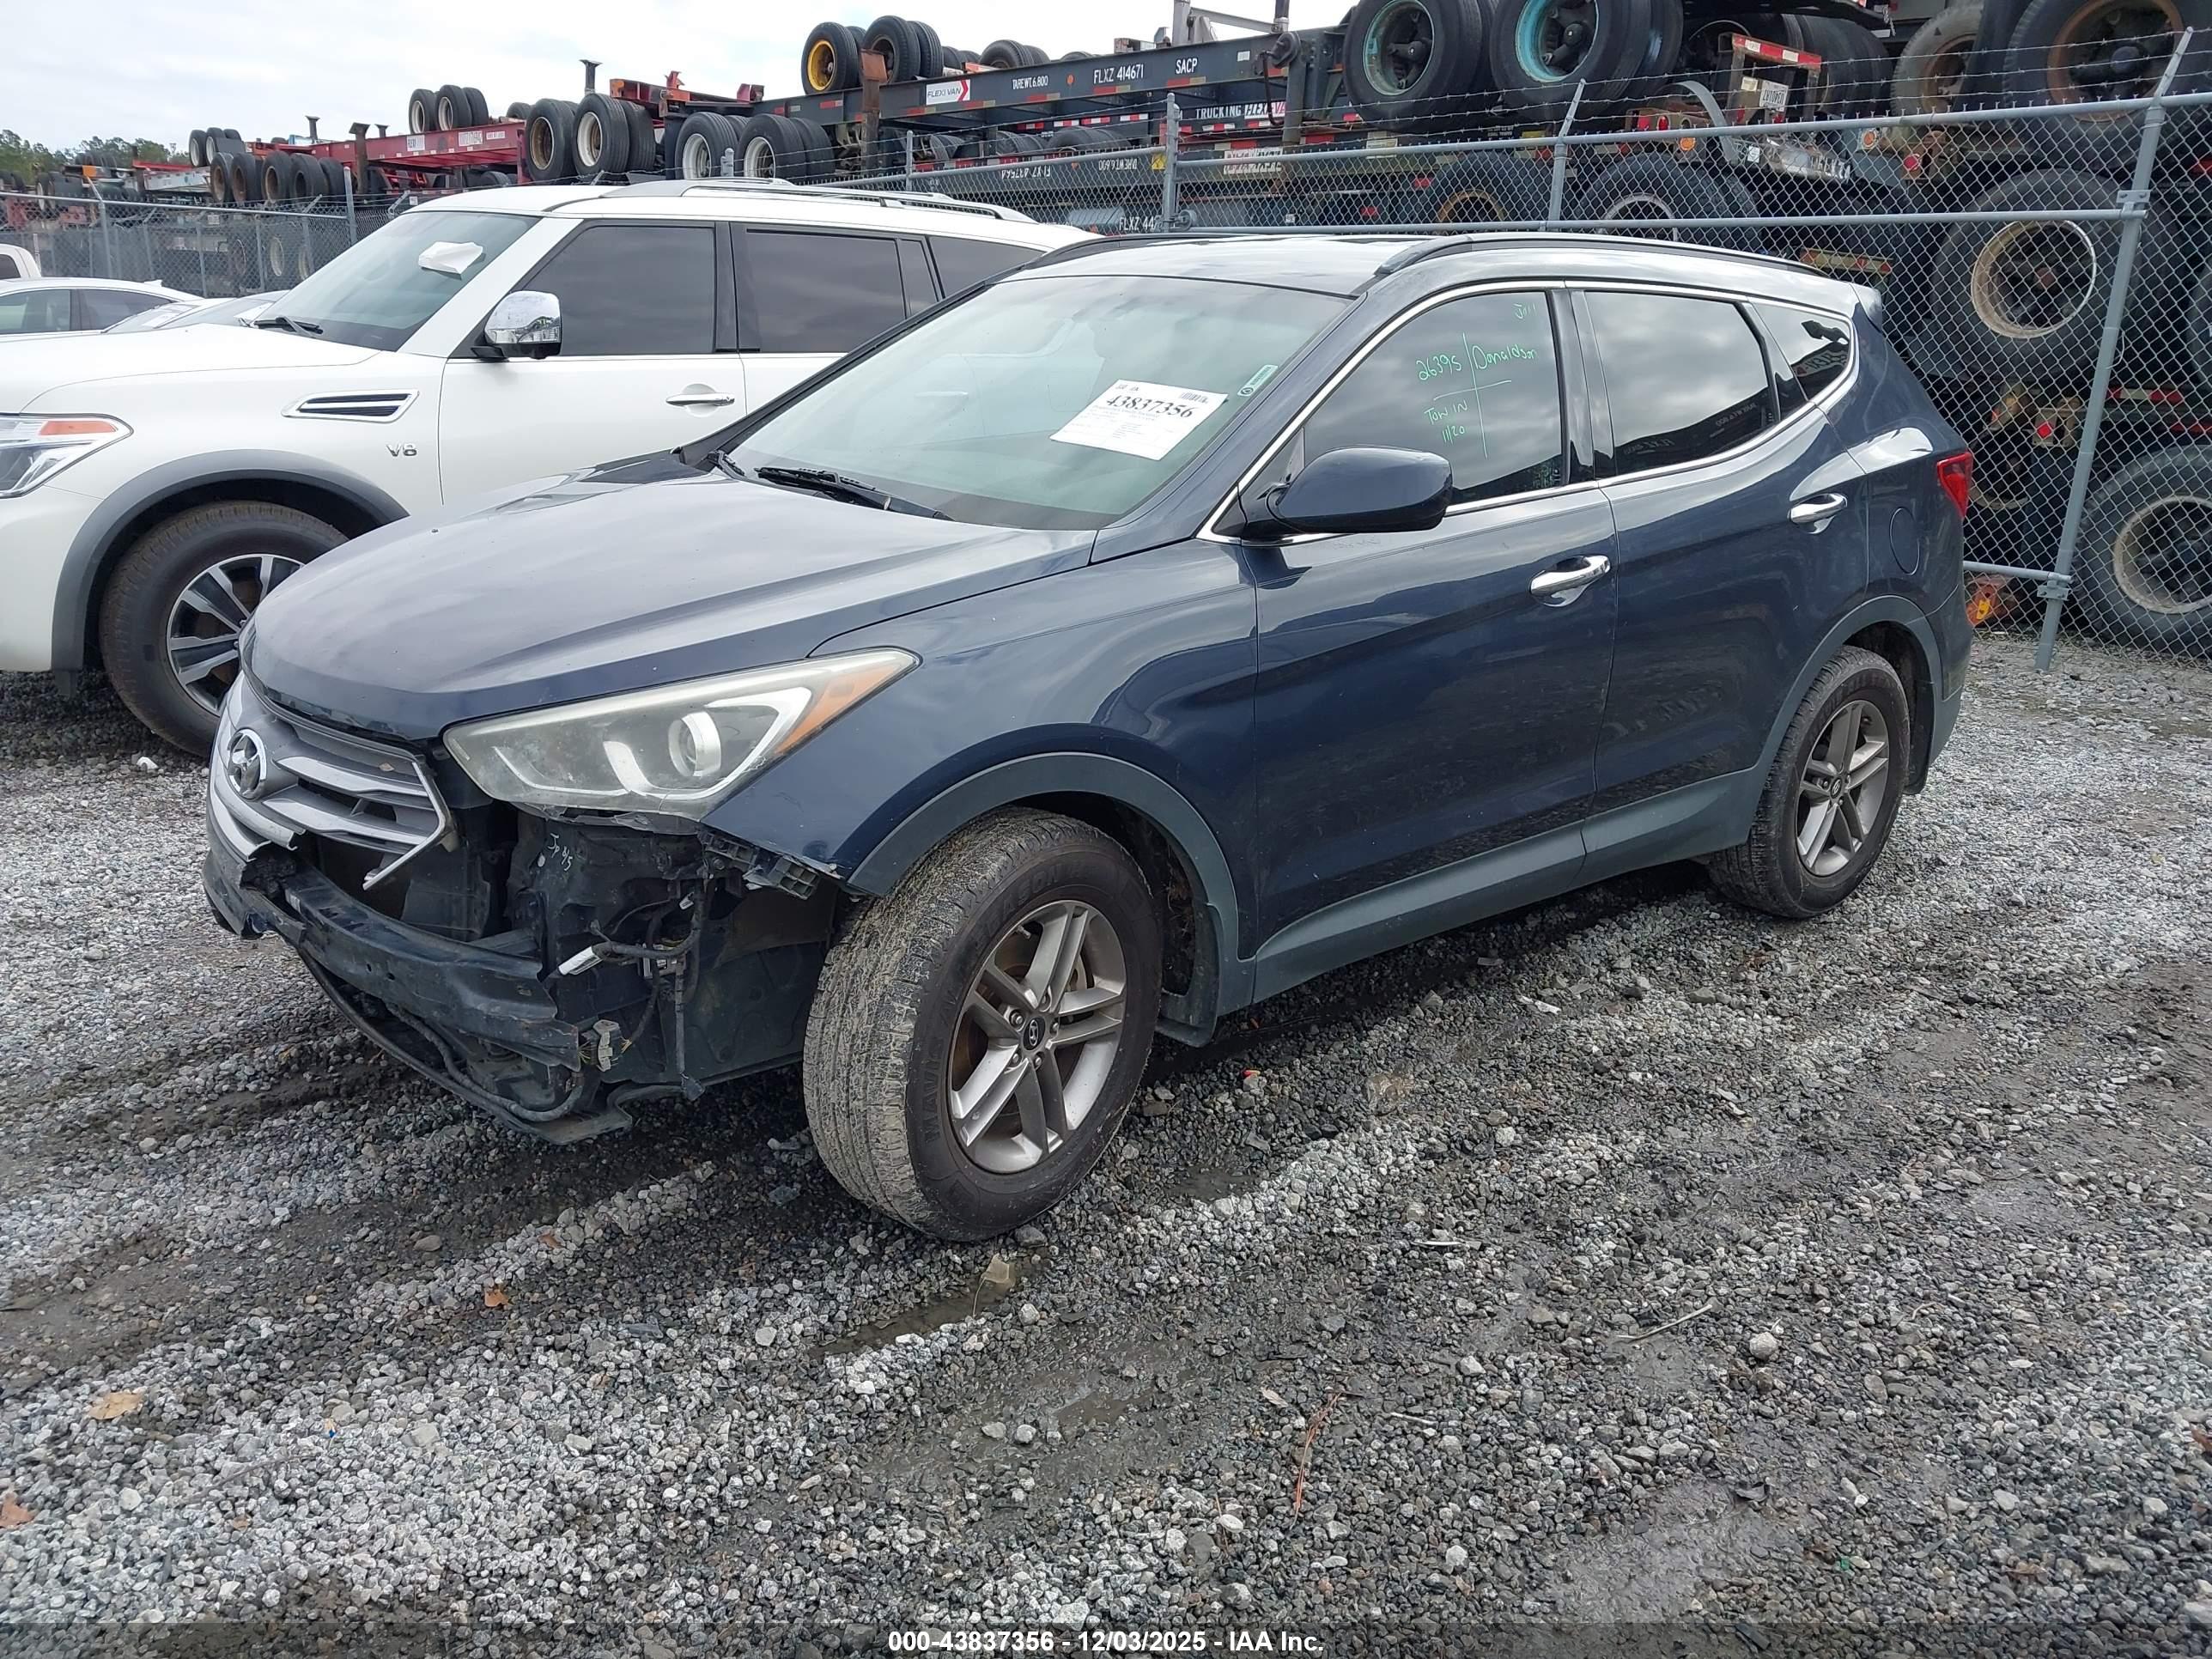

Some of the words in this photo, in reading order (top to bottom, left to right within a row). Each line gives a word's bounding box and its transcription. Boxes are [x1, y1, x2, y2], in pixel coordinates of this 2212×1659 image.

[1093, 67, 1115, 84] FLXZ
[1116, 64, 1144, 81] 414671
[1176, 58, 1198, 75] SACP
[947, 87, 962, 95] VAN
[1195, 104, 1242, 119] TRUCKING
[1472, 343, 1537, 369] Donaldson
[1106, 394, 1194, 419] 43837356
